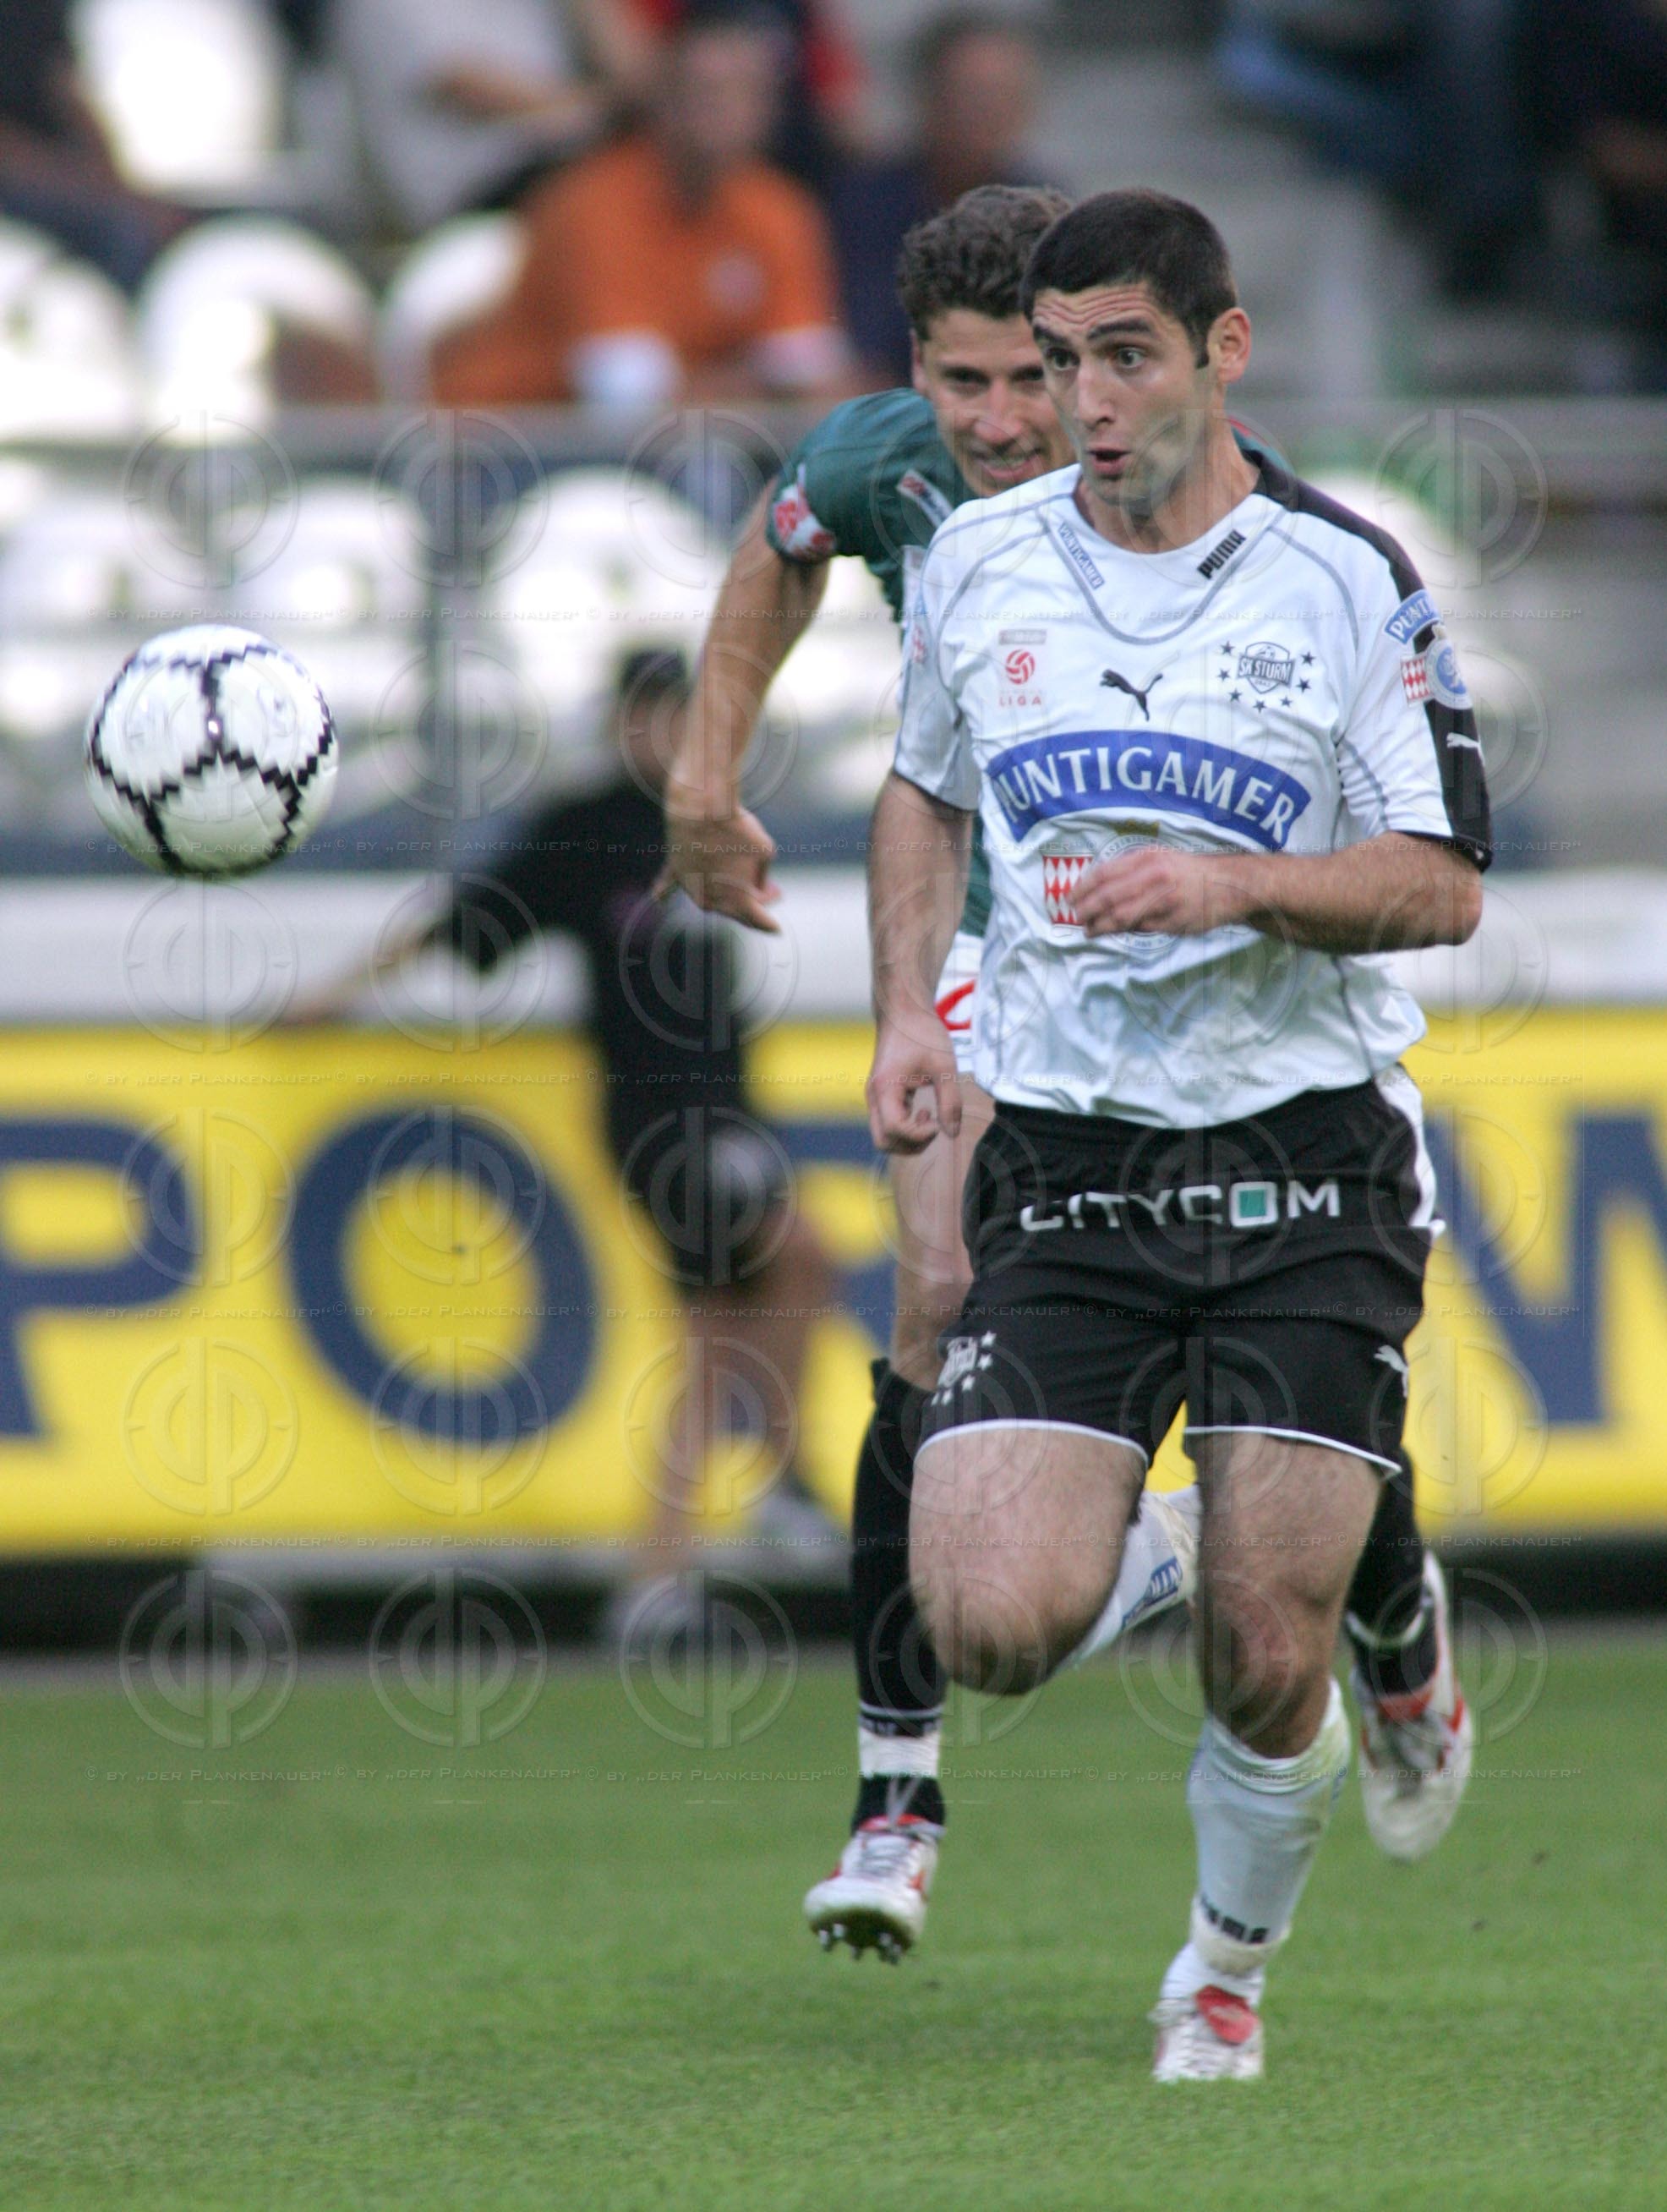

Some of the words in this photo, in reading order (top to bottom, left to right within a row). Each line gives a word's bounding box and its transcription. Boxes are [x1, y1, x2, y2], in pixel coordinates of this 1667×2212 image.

[1197, 528, 1246, 579] PUMA
[1254, 660, 1293, 685] STURM
[999, 695, 1042, 706] LIGA
[1020, 1180, 1341, 1232] CITYCOM
